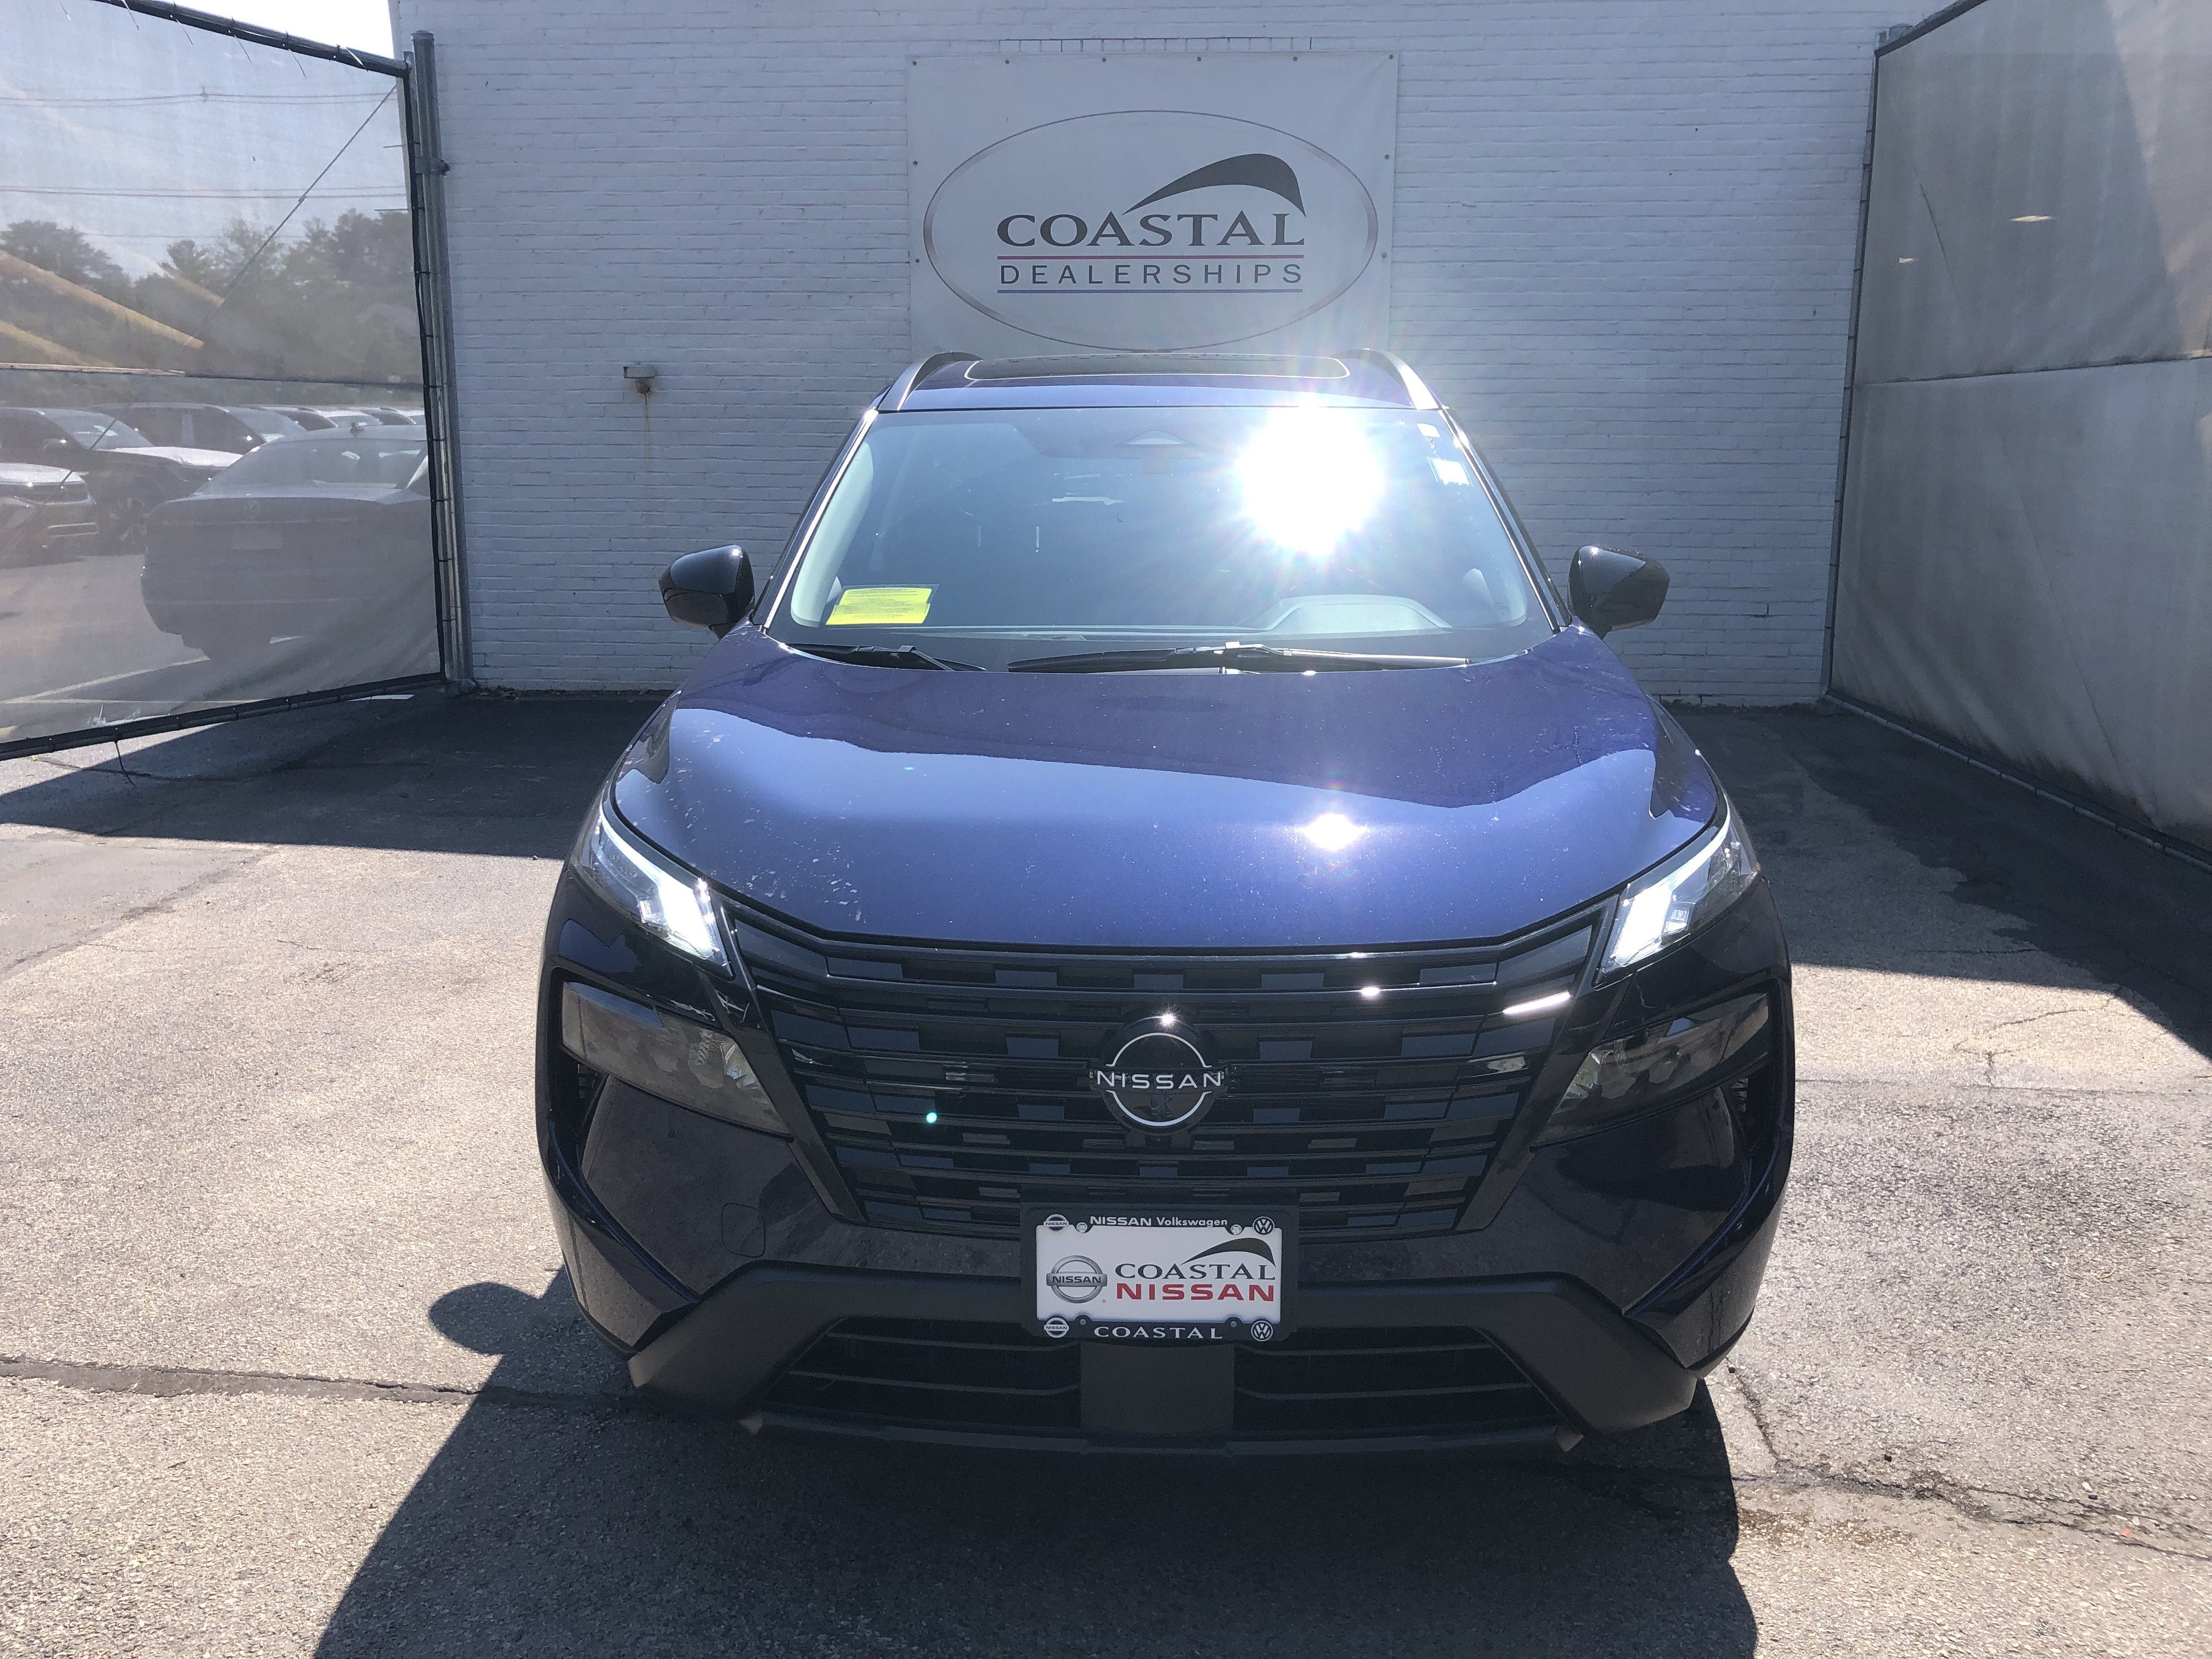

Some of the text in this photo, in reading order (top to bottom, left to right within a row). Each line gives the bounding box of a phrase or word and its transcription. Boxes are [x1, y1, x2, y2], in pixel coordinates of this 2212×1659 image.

[997, 211, 1305, 247] COASTAL
[1000, 264, 1302, 284] DEALERSHIPS
[1097, 1070, 1221, 1089] NISSAN
[1090, 1216, 1228, 1227] NISSAN Volkswagen
[1115, 1263, 1276, 1280] COASTAL
[1116, 1283, 1274, 1301] NISSAN
[1094, 1326, 1223, 1339] COASTAL
